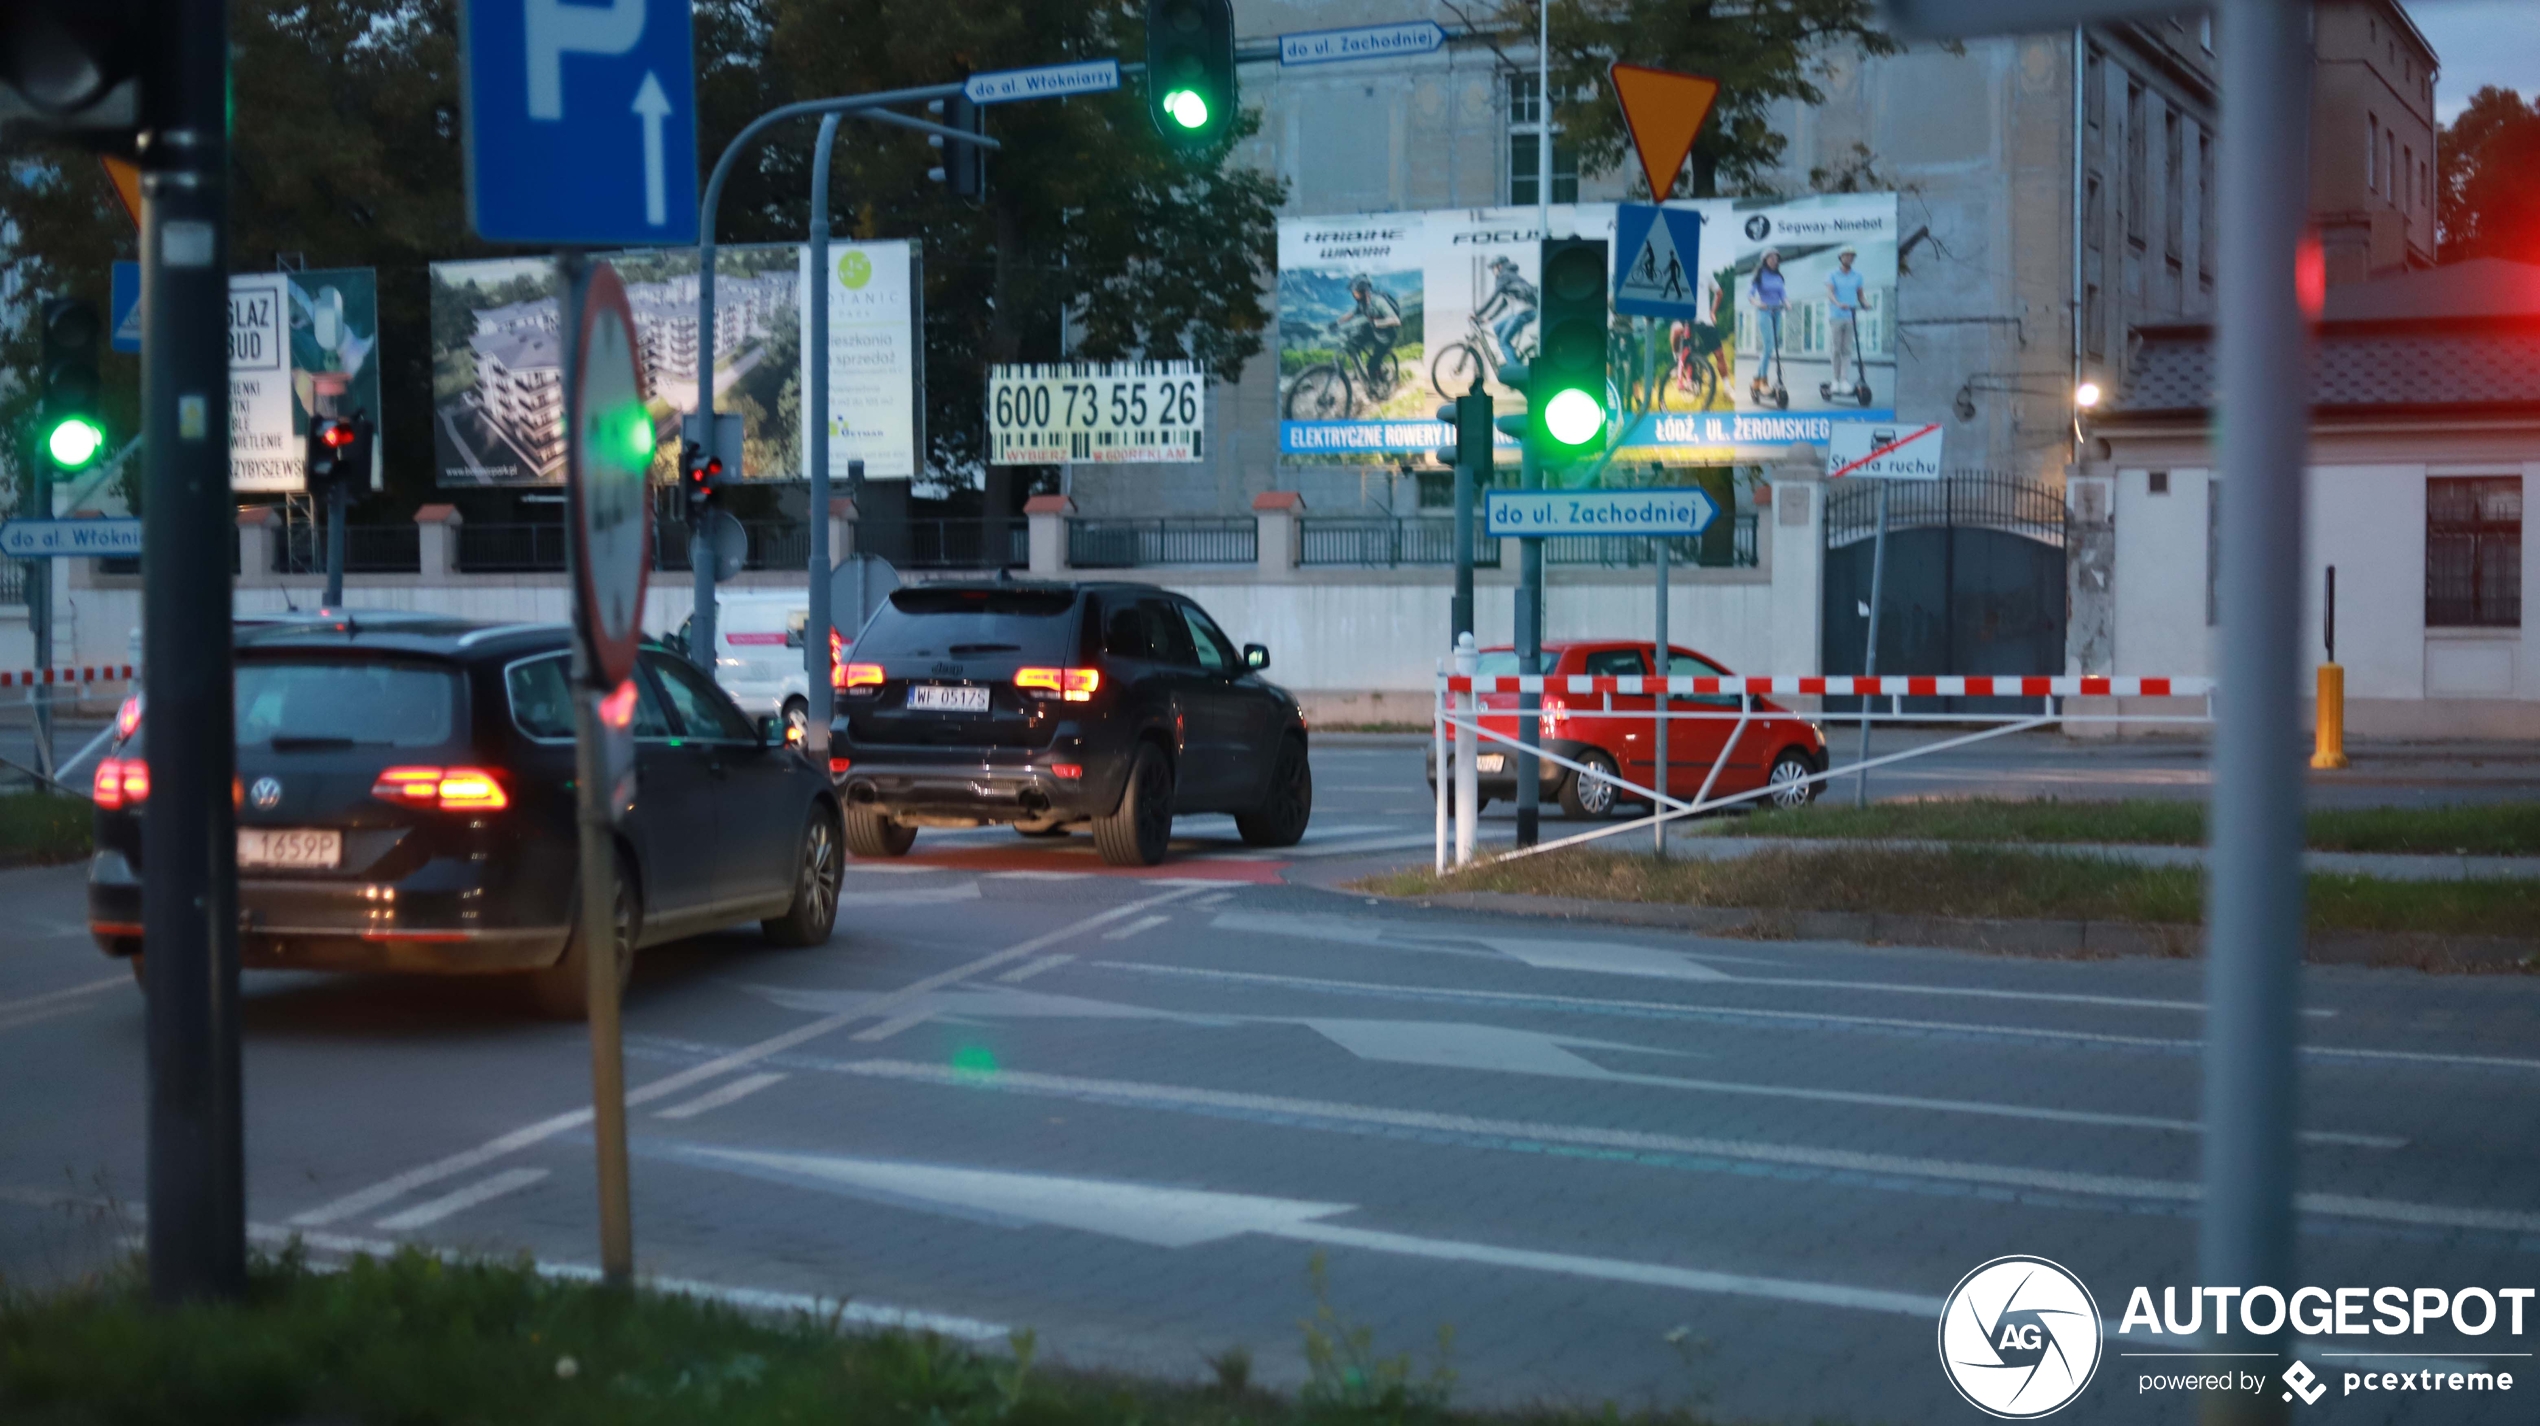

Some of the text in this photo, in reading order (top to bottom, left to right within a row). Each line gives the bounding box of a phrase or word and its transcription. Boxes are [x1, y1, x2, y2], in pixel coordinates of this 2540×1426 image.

[1287, 28, 1433, 57] do ul. Zachodniej
[975, 69, 1112, 97] do al. Włókniarzy
[1777, 217, 1883, 234] Segway-Ninebot
[830, 332, 892, 348] ieszkania
[996, 380, 1197, 428] 600 73 55 26
[1290, 425, 1383, 448] ELEKTRYCZNE
[1385, 424, 1443, 448] ROWERY
[1655, 414, 1700, 444] ŁÓDŹ,
[1705, 418, 1730, 442] UL.
[1734, 414, 1830, 442] ŻEROMSKIEG
[1005, 447, 1188, 462] WYBIERZ 600REKLAM
[1889, 457, 1936, 475] ruchu
[1495, 500, 1697, 528] do ul. Zachodniej
[10, 527, 139, 547] do al. Włókni
[917, 687, 934, 705] WF
[261, 832, 334, 860] 1659P
